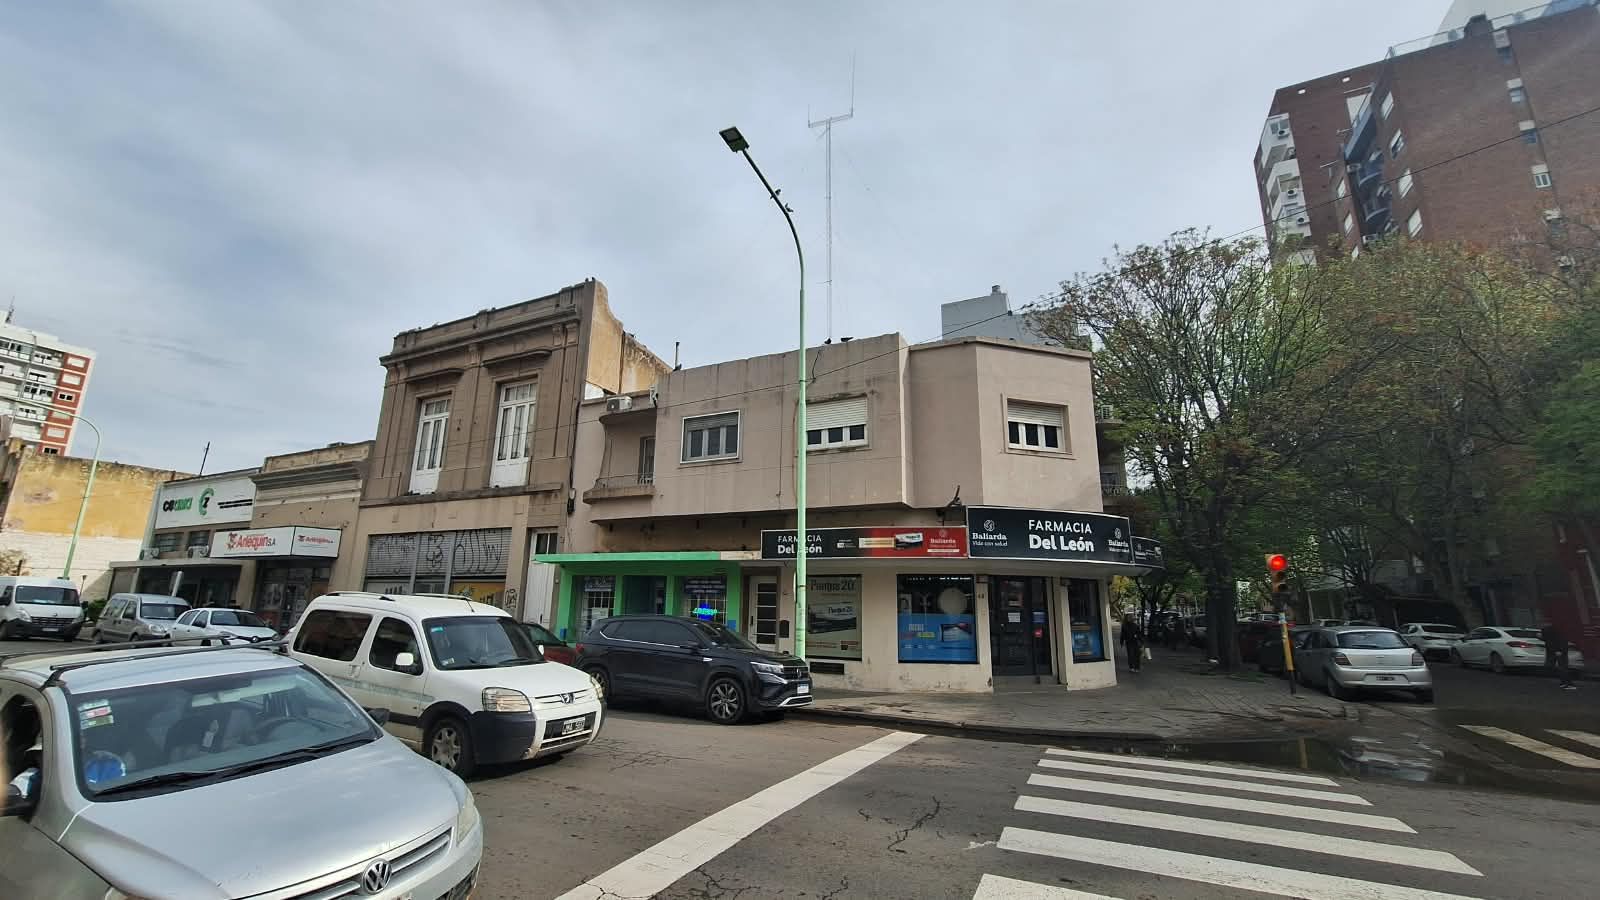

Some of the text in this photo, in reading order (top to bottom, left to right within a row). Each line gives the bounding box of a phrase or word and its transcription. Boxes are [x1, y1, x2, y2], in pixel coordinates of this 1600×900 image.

[1028, 519, 1092, 534] FARMACIA
[972, 532, 1007, 540] Baliarda
[777, 544, 796, 554] Del
[1029, 534, 1094, 552] Del León
